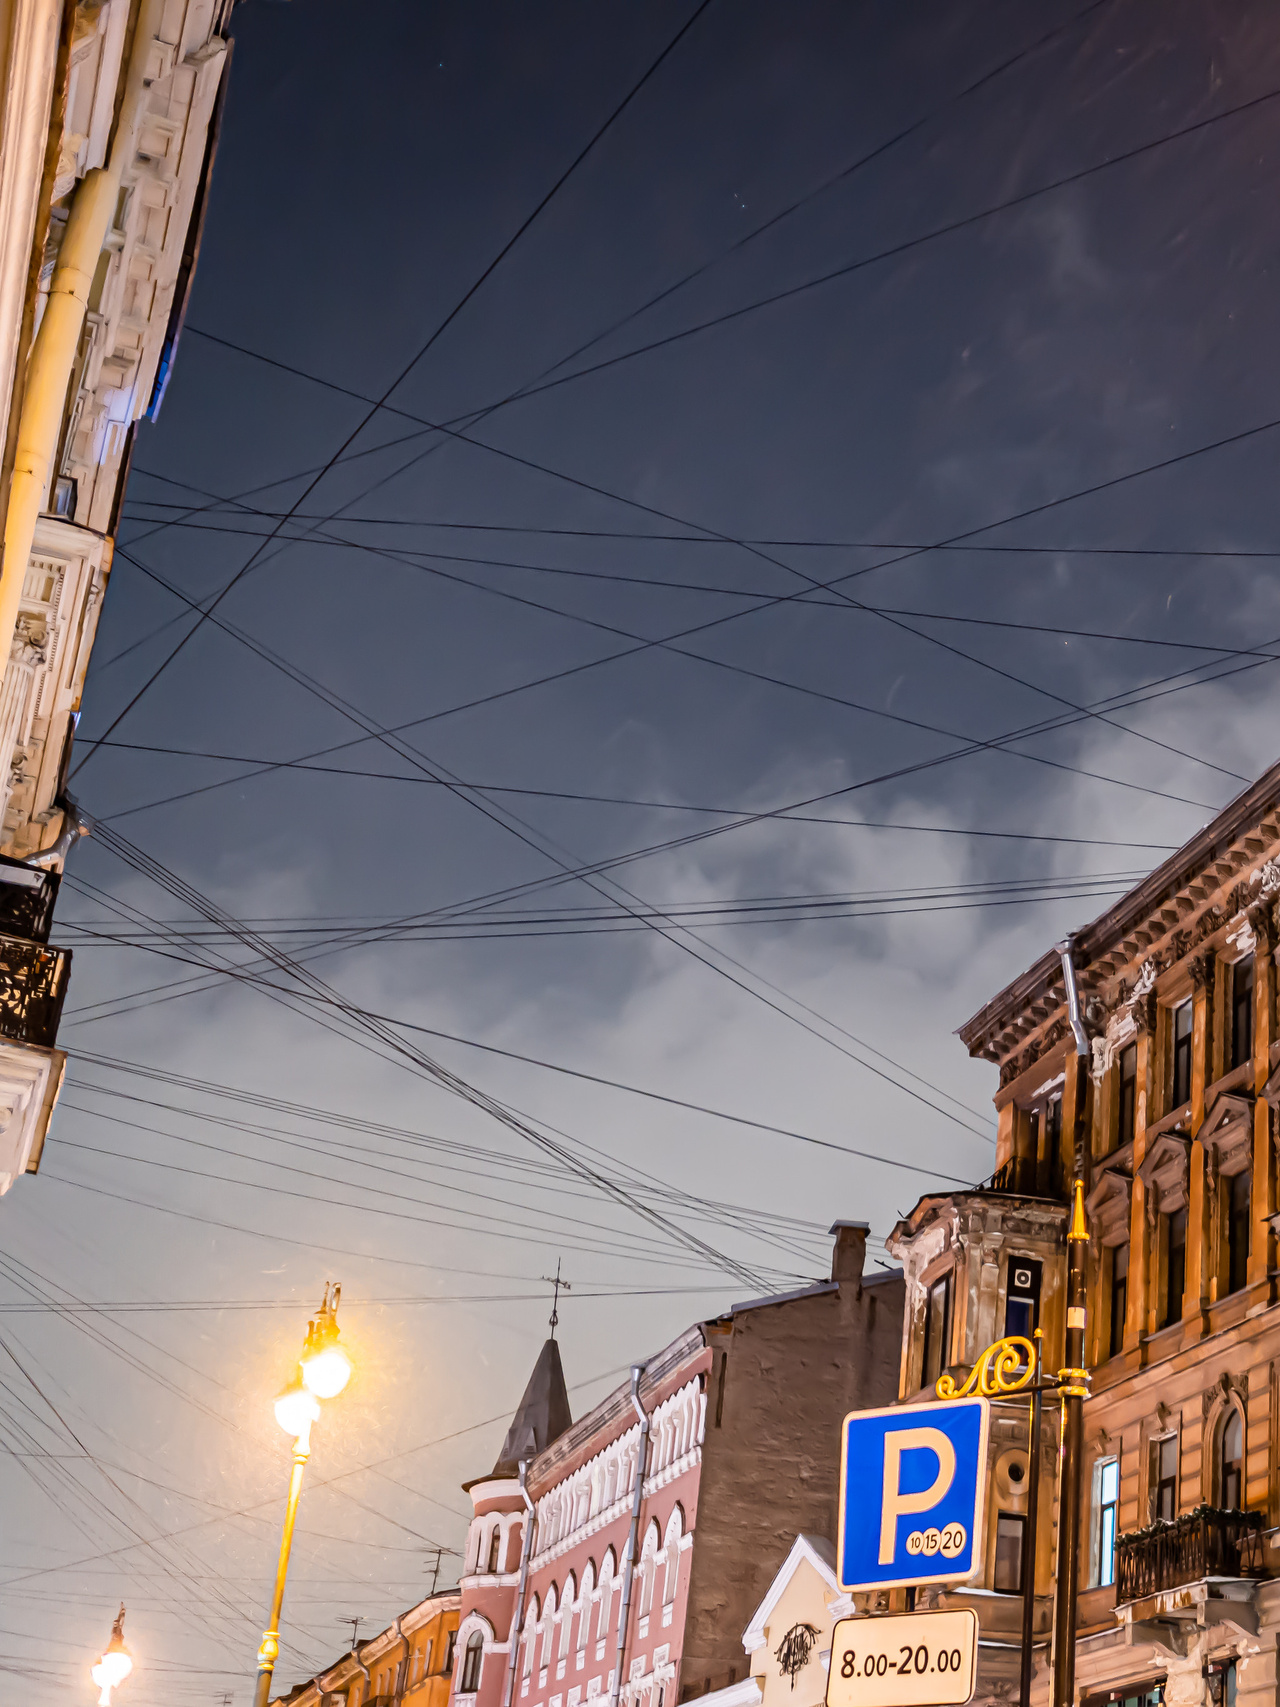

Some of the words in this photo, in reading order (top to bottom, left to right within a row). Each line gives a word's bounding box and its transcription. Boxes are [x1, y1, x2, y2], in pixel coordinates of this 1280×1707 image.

[878, 1426, 956, 1565] P
[911, 1536, 921, 1549] 10
[926, 1534, 938, 1549] 15
[942, 1530, 963, 1549] 20
[840, 1644, 962, 1679] 8.00-20.00
